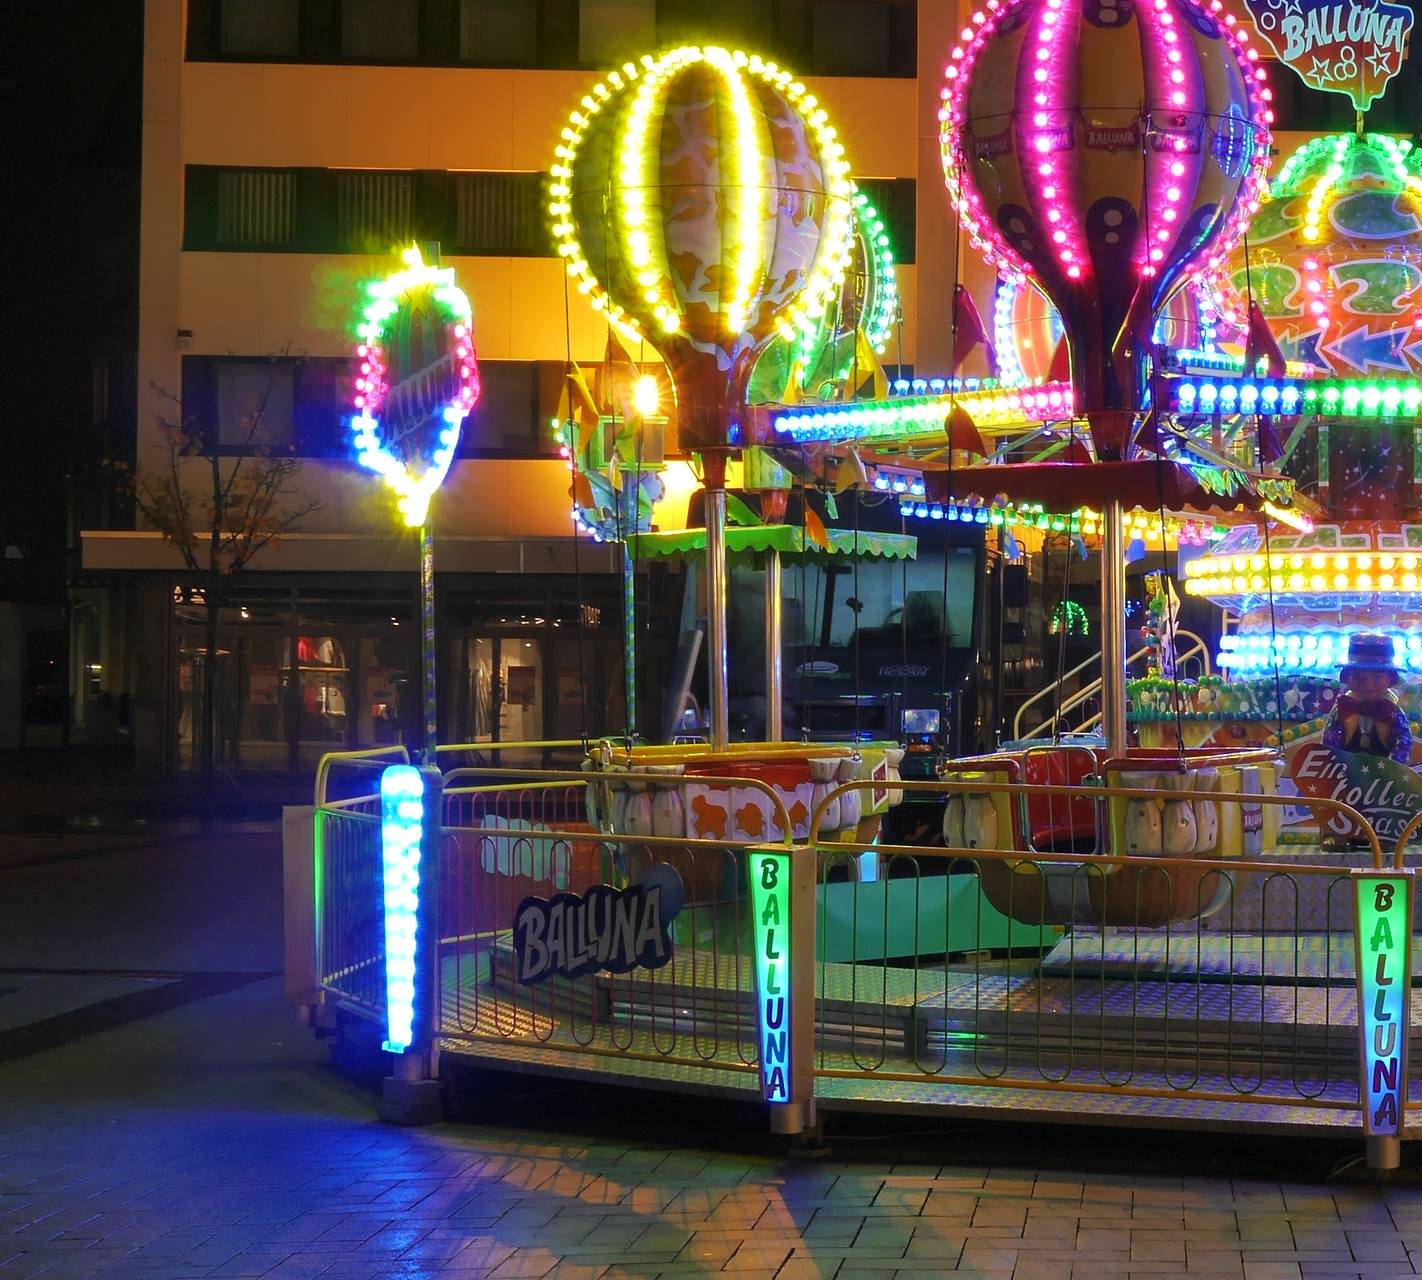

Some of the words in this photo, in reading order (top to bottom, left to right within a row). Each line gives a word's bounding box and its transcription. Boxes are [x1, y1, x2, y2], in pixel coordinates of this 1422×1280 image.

[1281, 4, 1405, 61] BALLUNA
[1296, 750, 1348, 779] Ein
[1330, 777, 1419, 808] toller
[519, 887, 665, 980] BALLUNA
[761, 858, 786, 1099] BALLUNA
[1371, 883, 1398, 1127] BALLUNA
